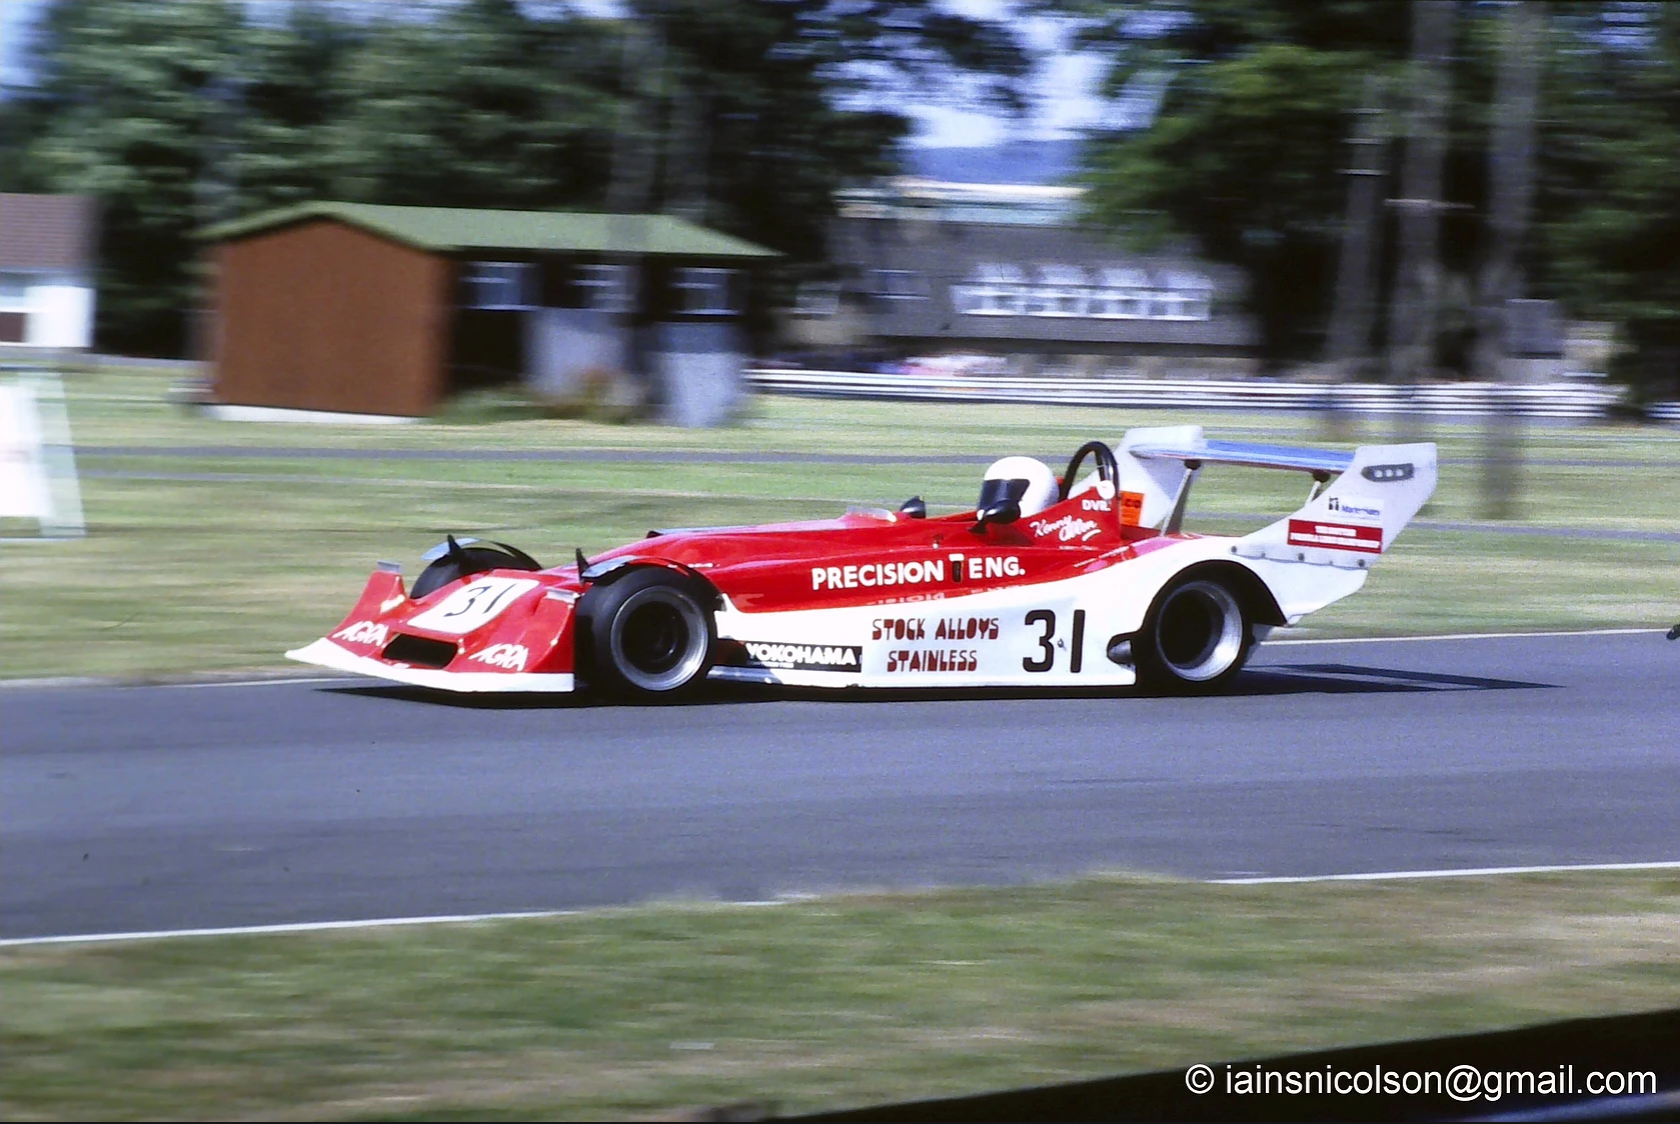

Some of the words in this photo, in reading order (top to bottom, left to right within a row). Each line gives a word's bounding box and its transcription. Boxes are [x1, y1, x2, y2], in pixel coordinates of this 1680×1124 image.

[812, 560, 944, 590] PRECISION
[968, 556, 1026, 579] ENG.
[443, 583, 518, 617] 31
[872, 618, 926, 640] STOCK
[935, 617, 999, 640] ALLOYS
[1022, 609, 1086, 673] 31
[745, 642, 857, 666] YOKOHAMA
[887, 650, 977, 672] STAINLESS
